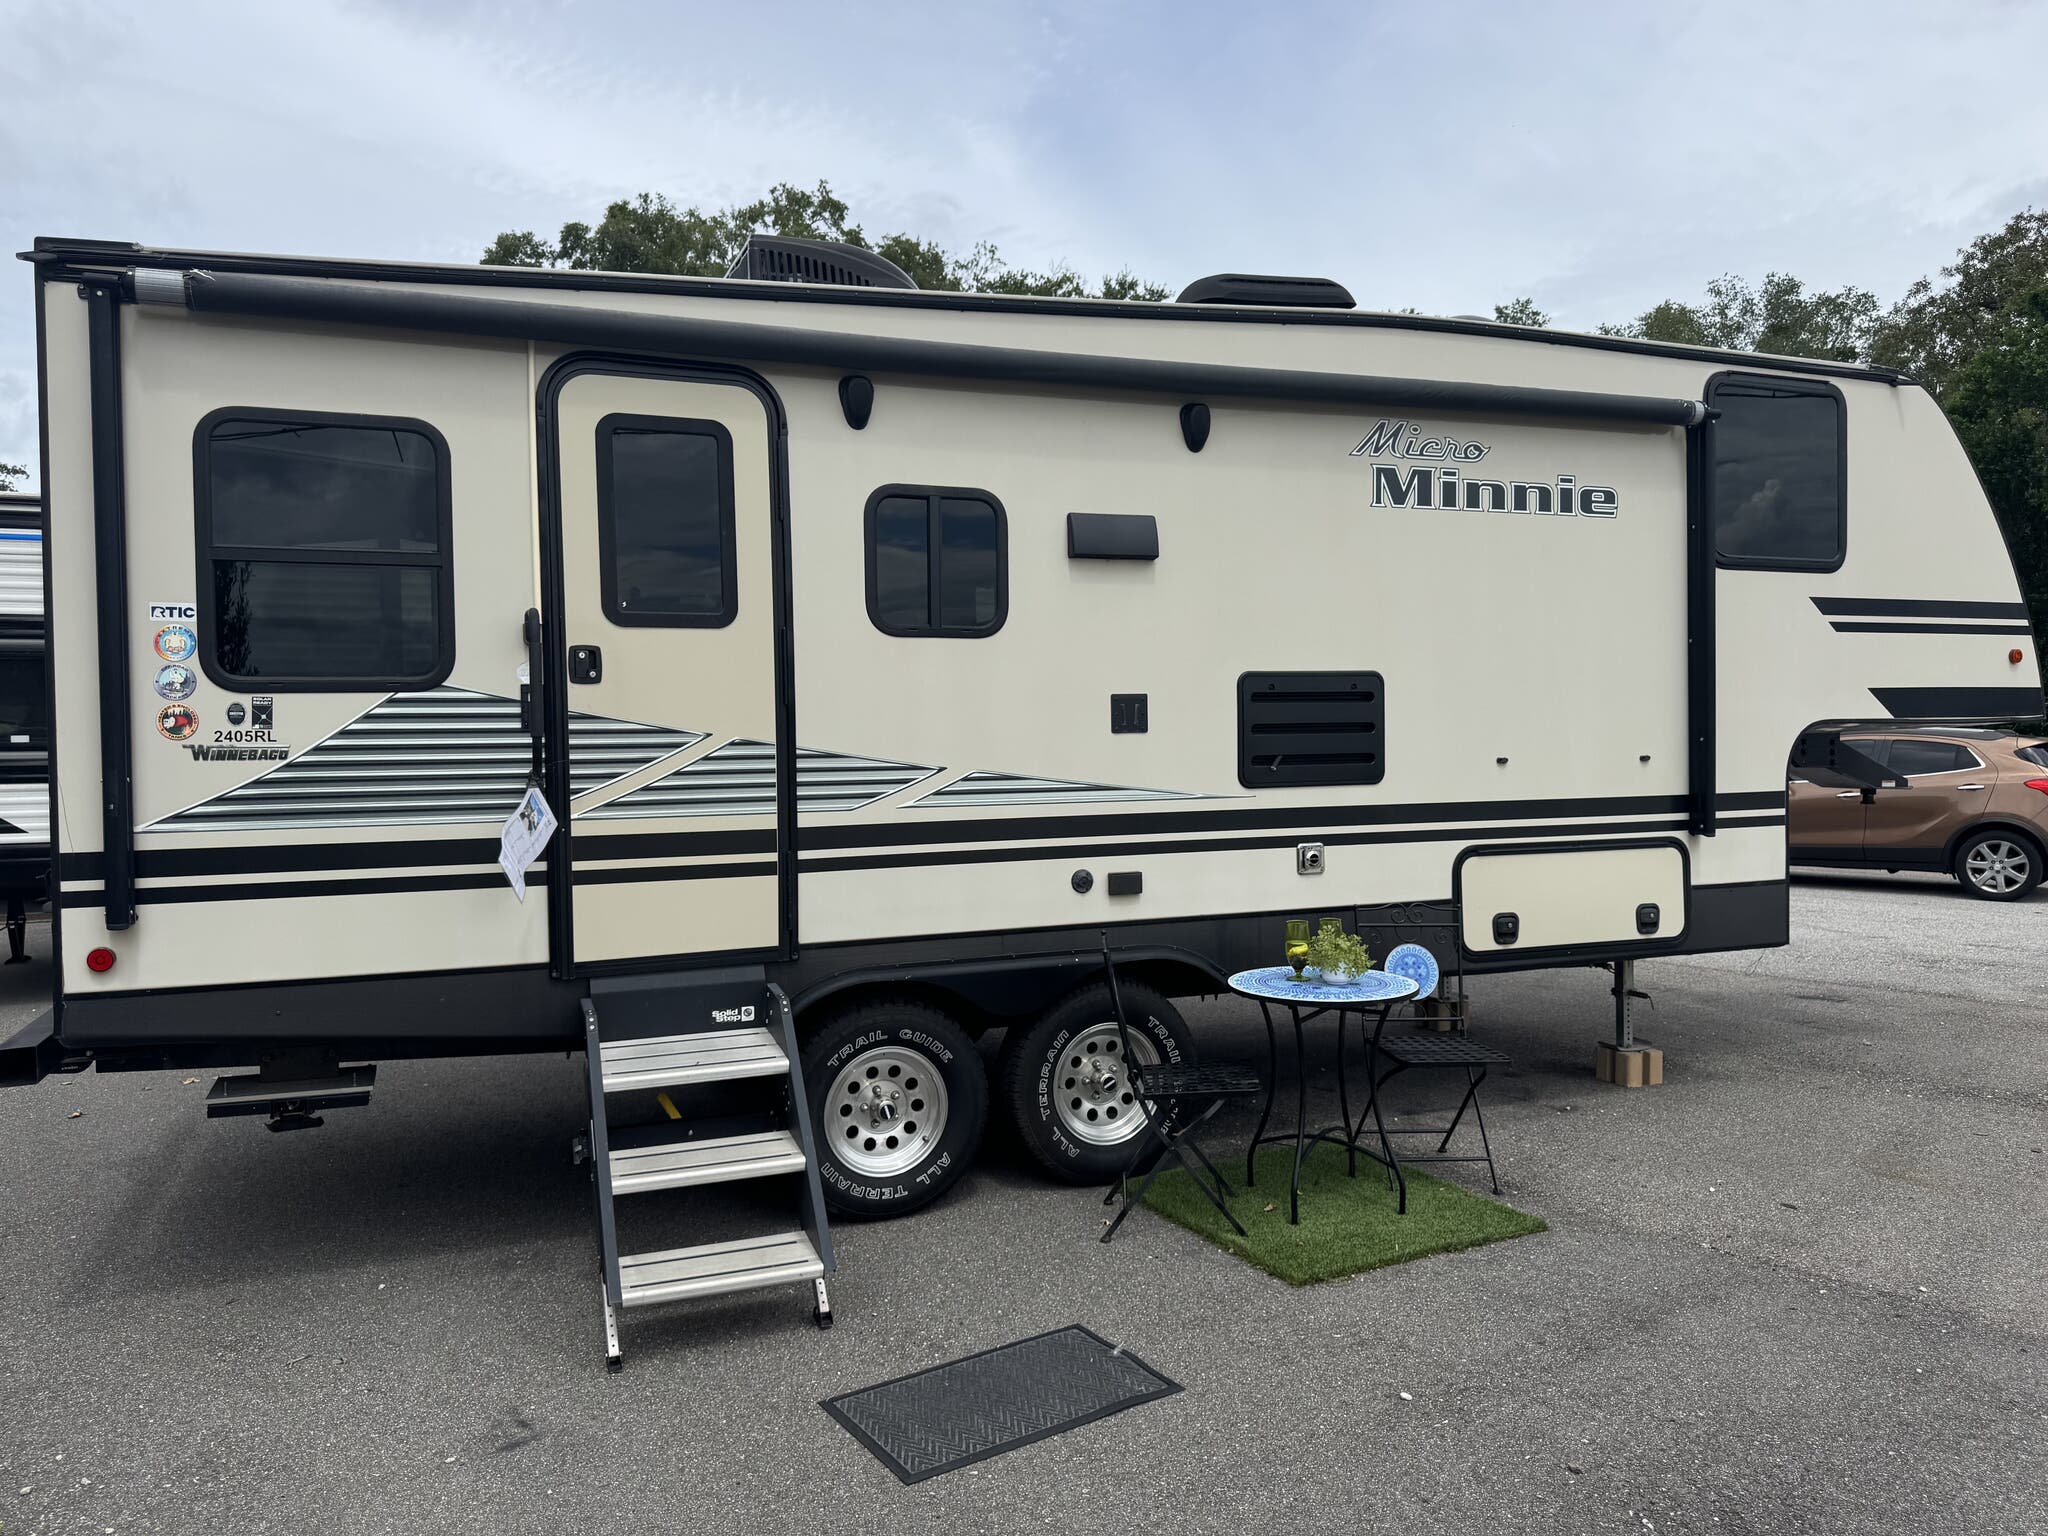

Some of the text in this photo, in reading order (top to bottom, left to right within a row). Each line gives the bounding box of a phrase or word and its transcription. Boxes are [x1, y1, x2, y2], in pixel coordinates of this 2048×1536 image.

[1349, 418, 1491, 463] Micro
[1369, 463, 1619, 519] Minnie
[151, 606, 195, 618] RTIC
[214, 730, 277, 742] 2405RL
[712, 1009, 738, 1017] Solid
[827, 1028, 953, 1068] TRAIL GUIDE
[1038, 1029, 1081, 1158] ALL TERRAIN
[820, 1152, 951, 1200] ALL TERRAIN
